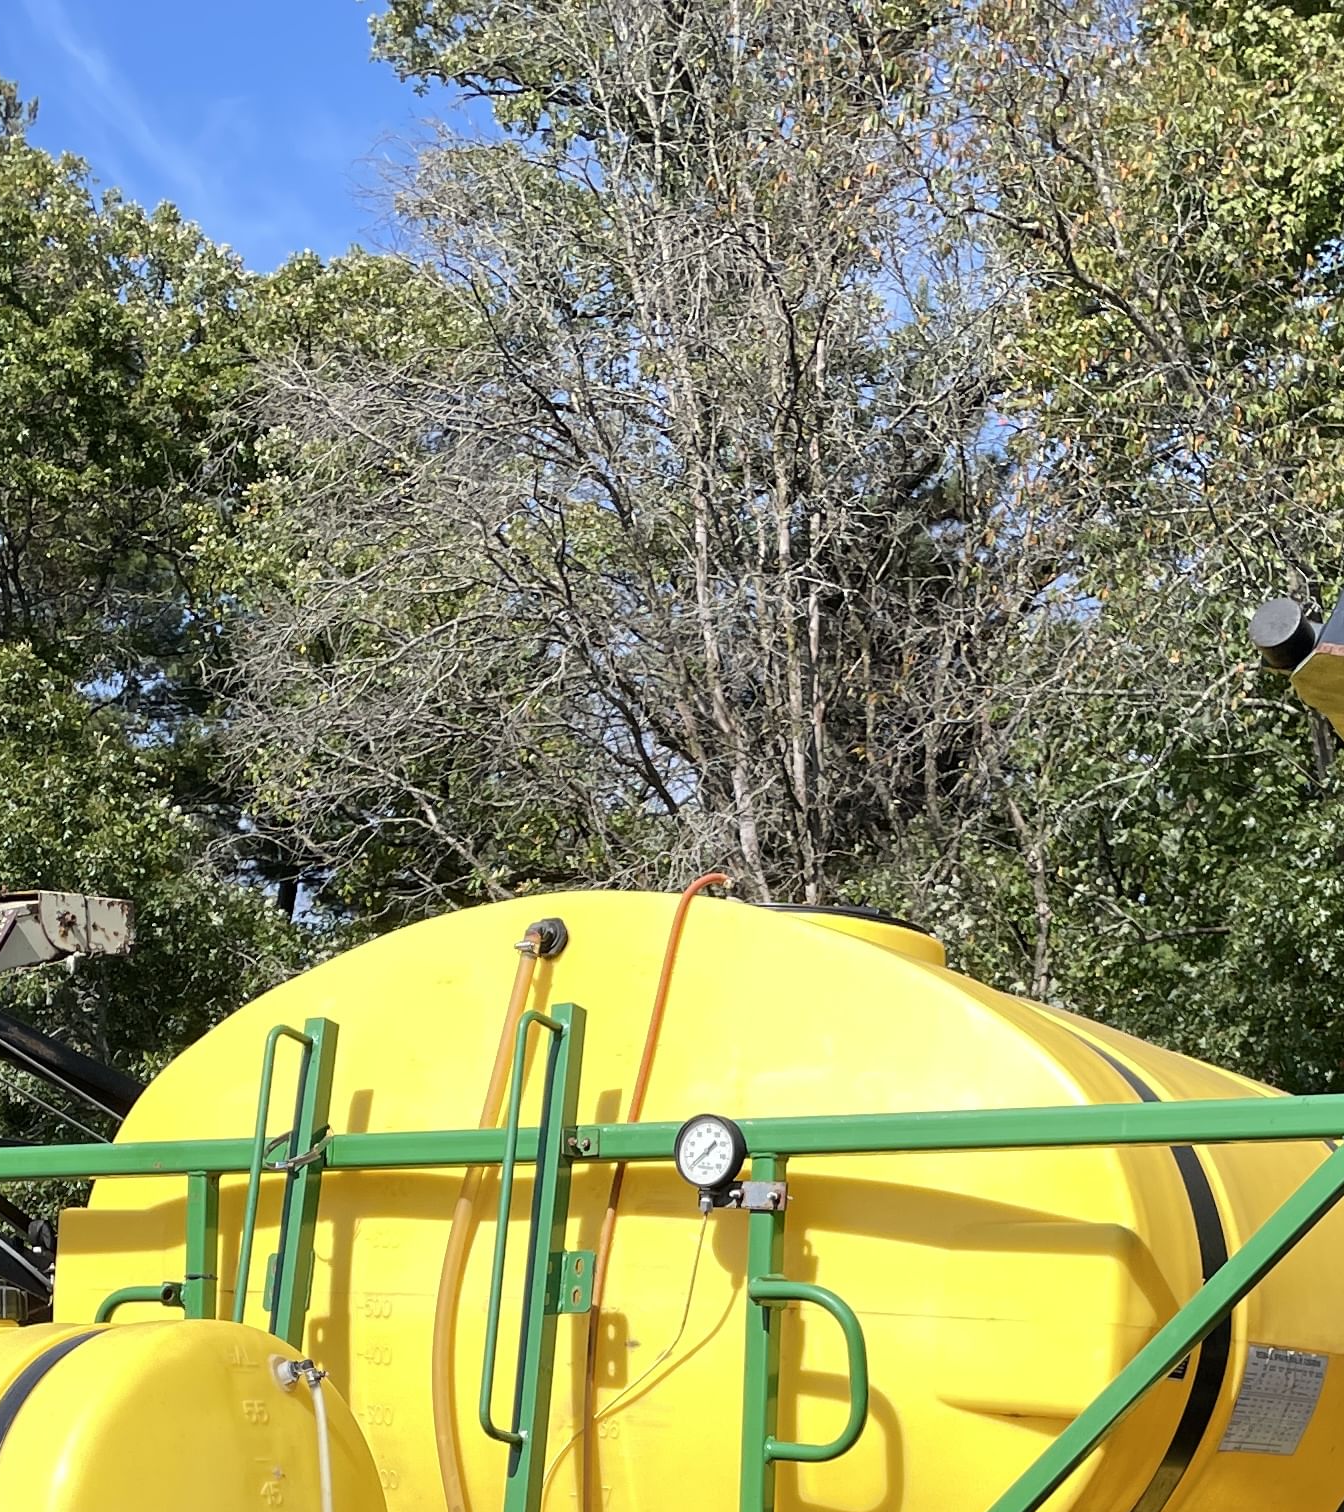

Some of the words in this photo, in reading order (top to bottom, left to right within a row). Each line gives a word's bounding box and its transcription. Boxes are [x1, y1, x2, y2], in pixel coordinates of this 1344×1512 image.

[365, 1346, 393, 1366] 400
[242, 1400, 270, 1425] 55
[259, 1480, 284, 1506] 45
